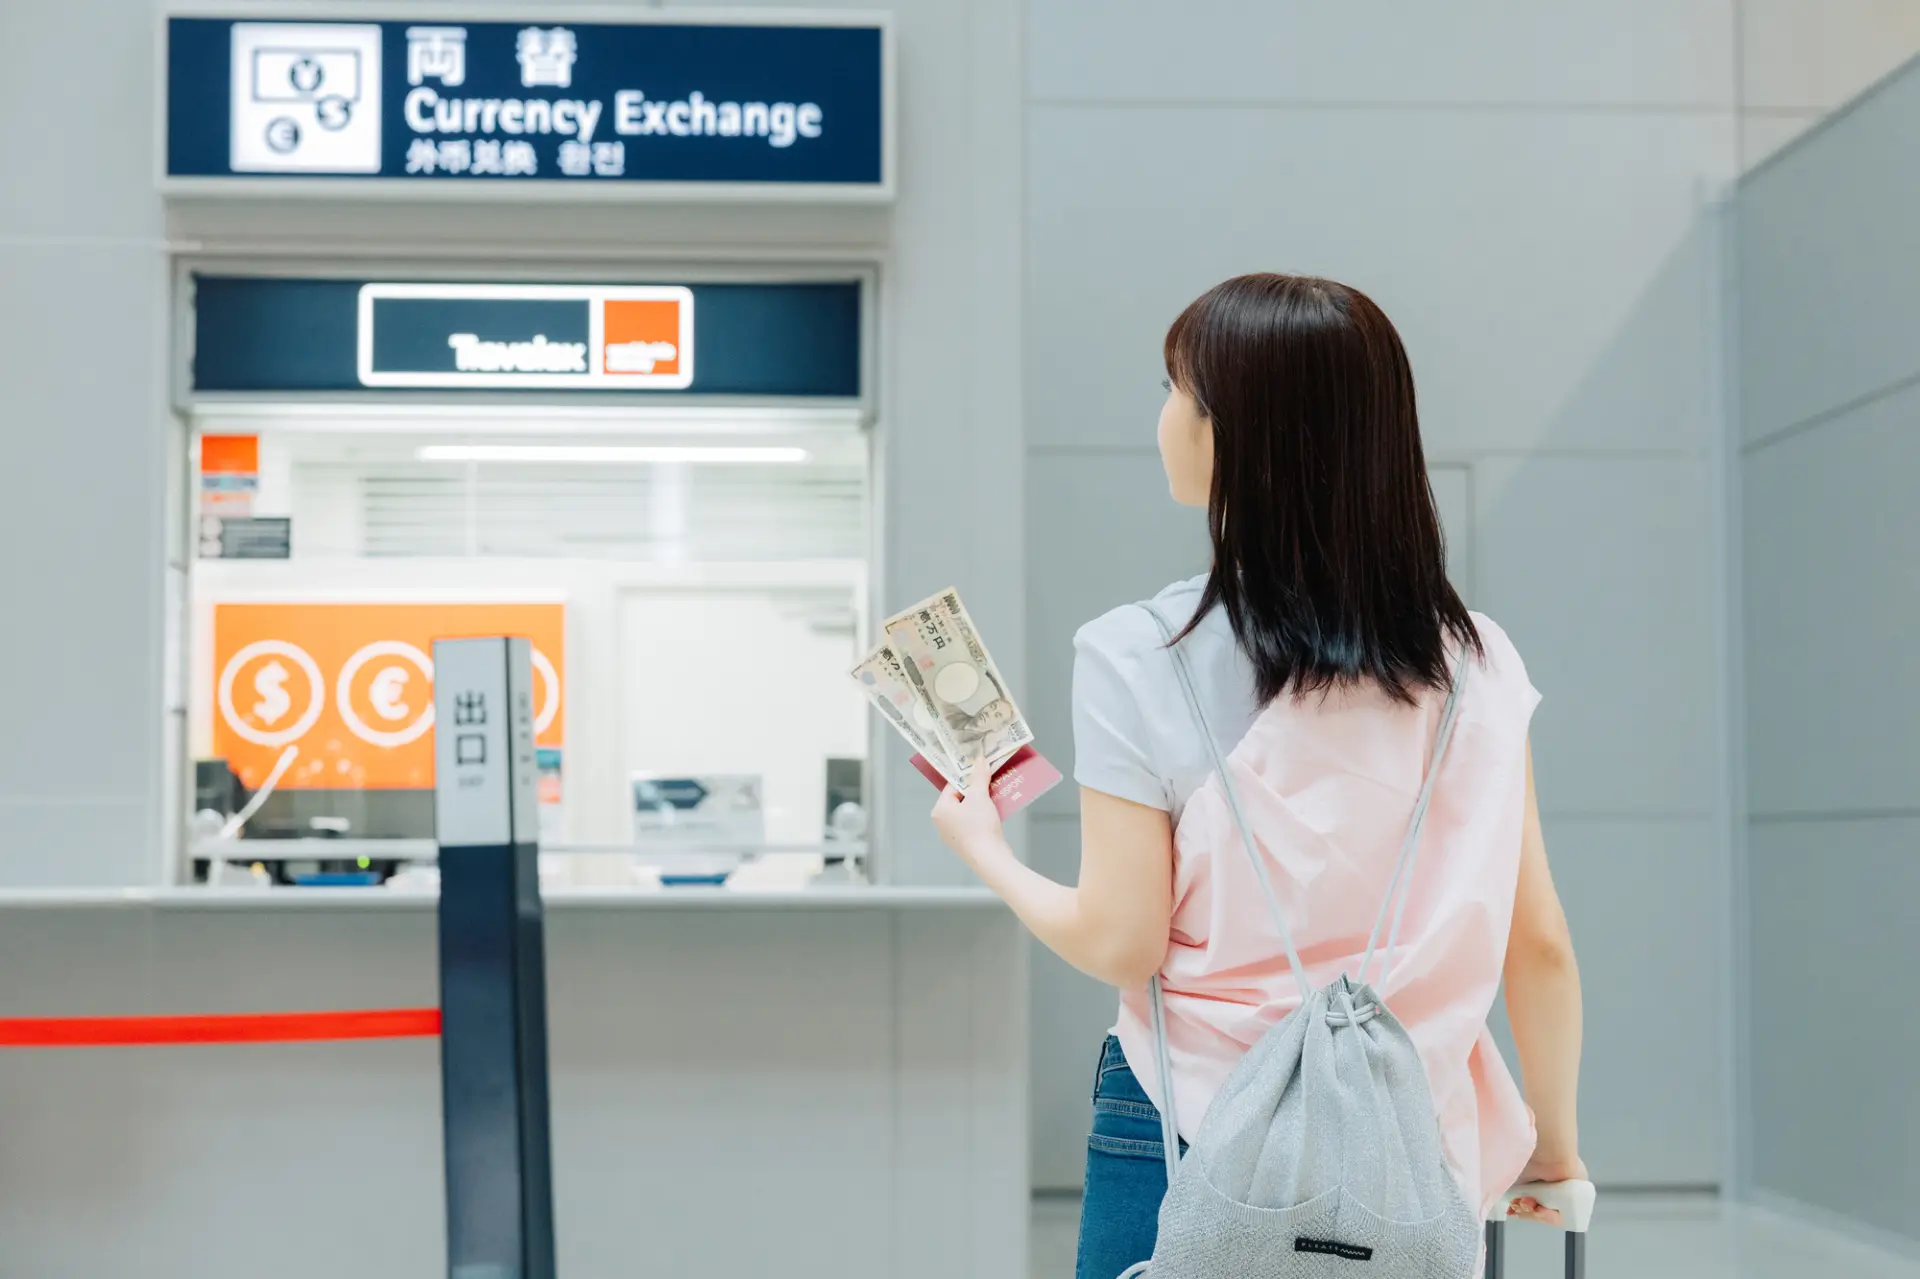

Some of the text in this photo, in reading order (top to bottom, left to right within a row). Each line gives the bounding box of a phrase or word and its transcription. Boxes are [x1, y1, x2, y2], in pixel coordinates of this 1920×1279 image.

[404, 86, 823, 148] Currency Exchange
[455, 690, 488, 766] 出口
